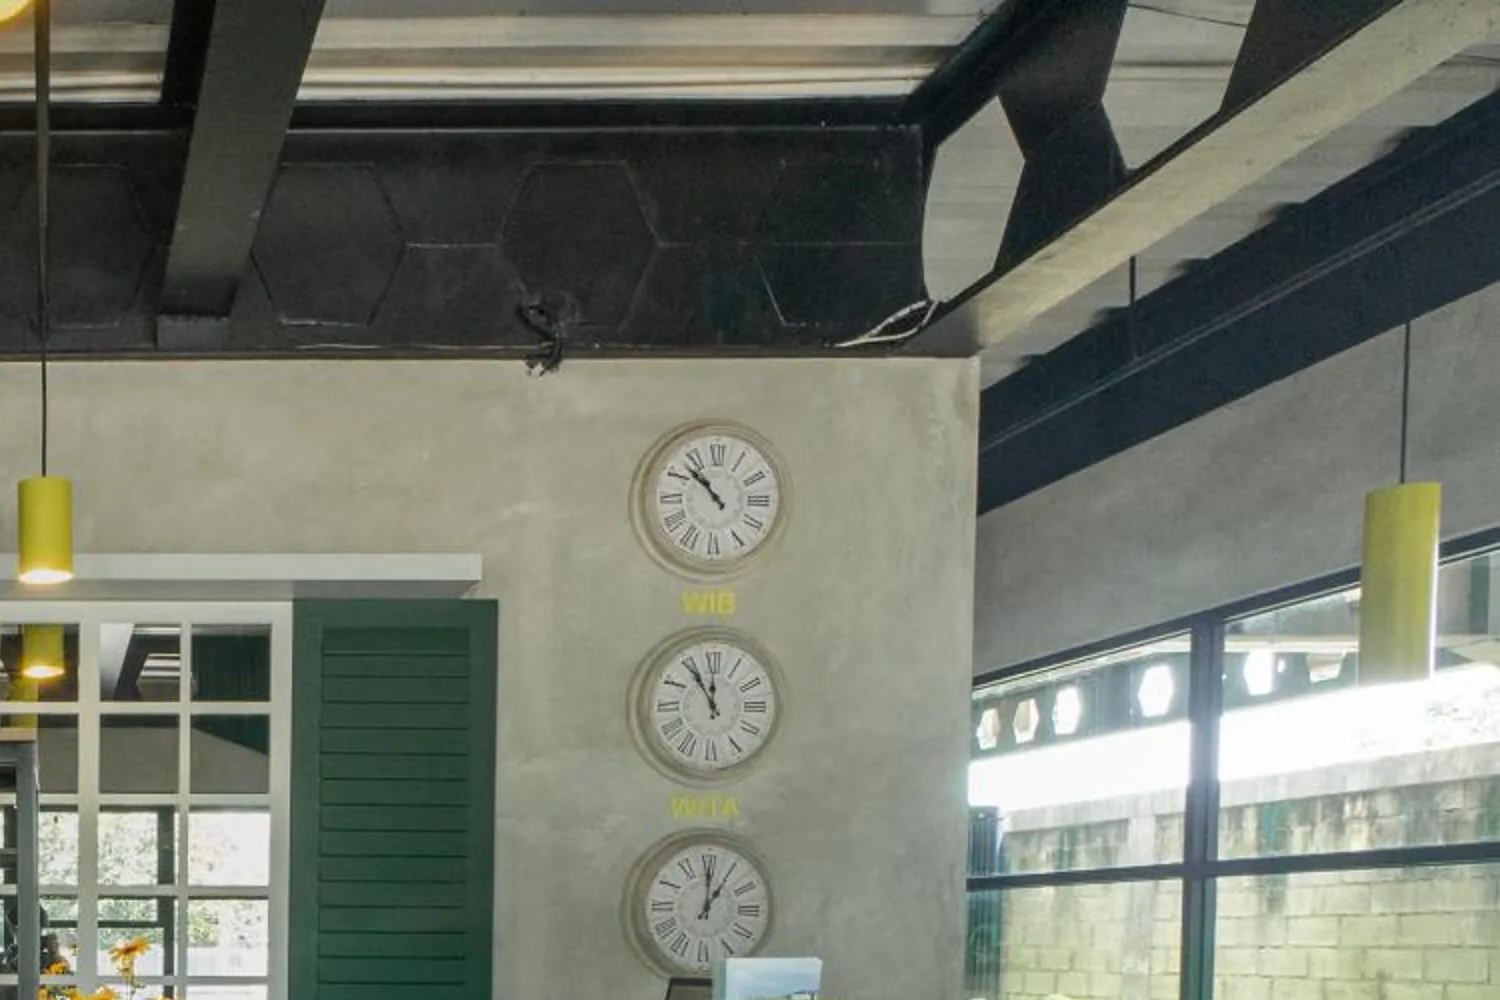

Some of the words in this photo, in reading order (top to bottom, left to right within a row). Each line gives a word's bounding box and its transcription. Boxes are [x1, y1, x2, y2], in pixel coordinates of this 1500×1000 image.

[747, 495, 770, 507] III
[681, 591, 736, 614] WIB
[743, 701, 766, 713] III
[738, 905, 760, 917] III
